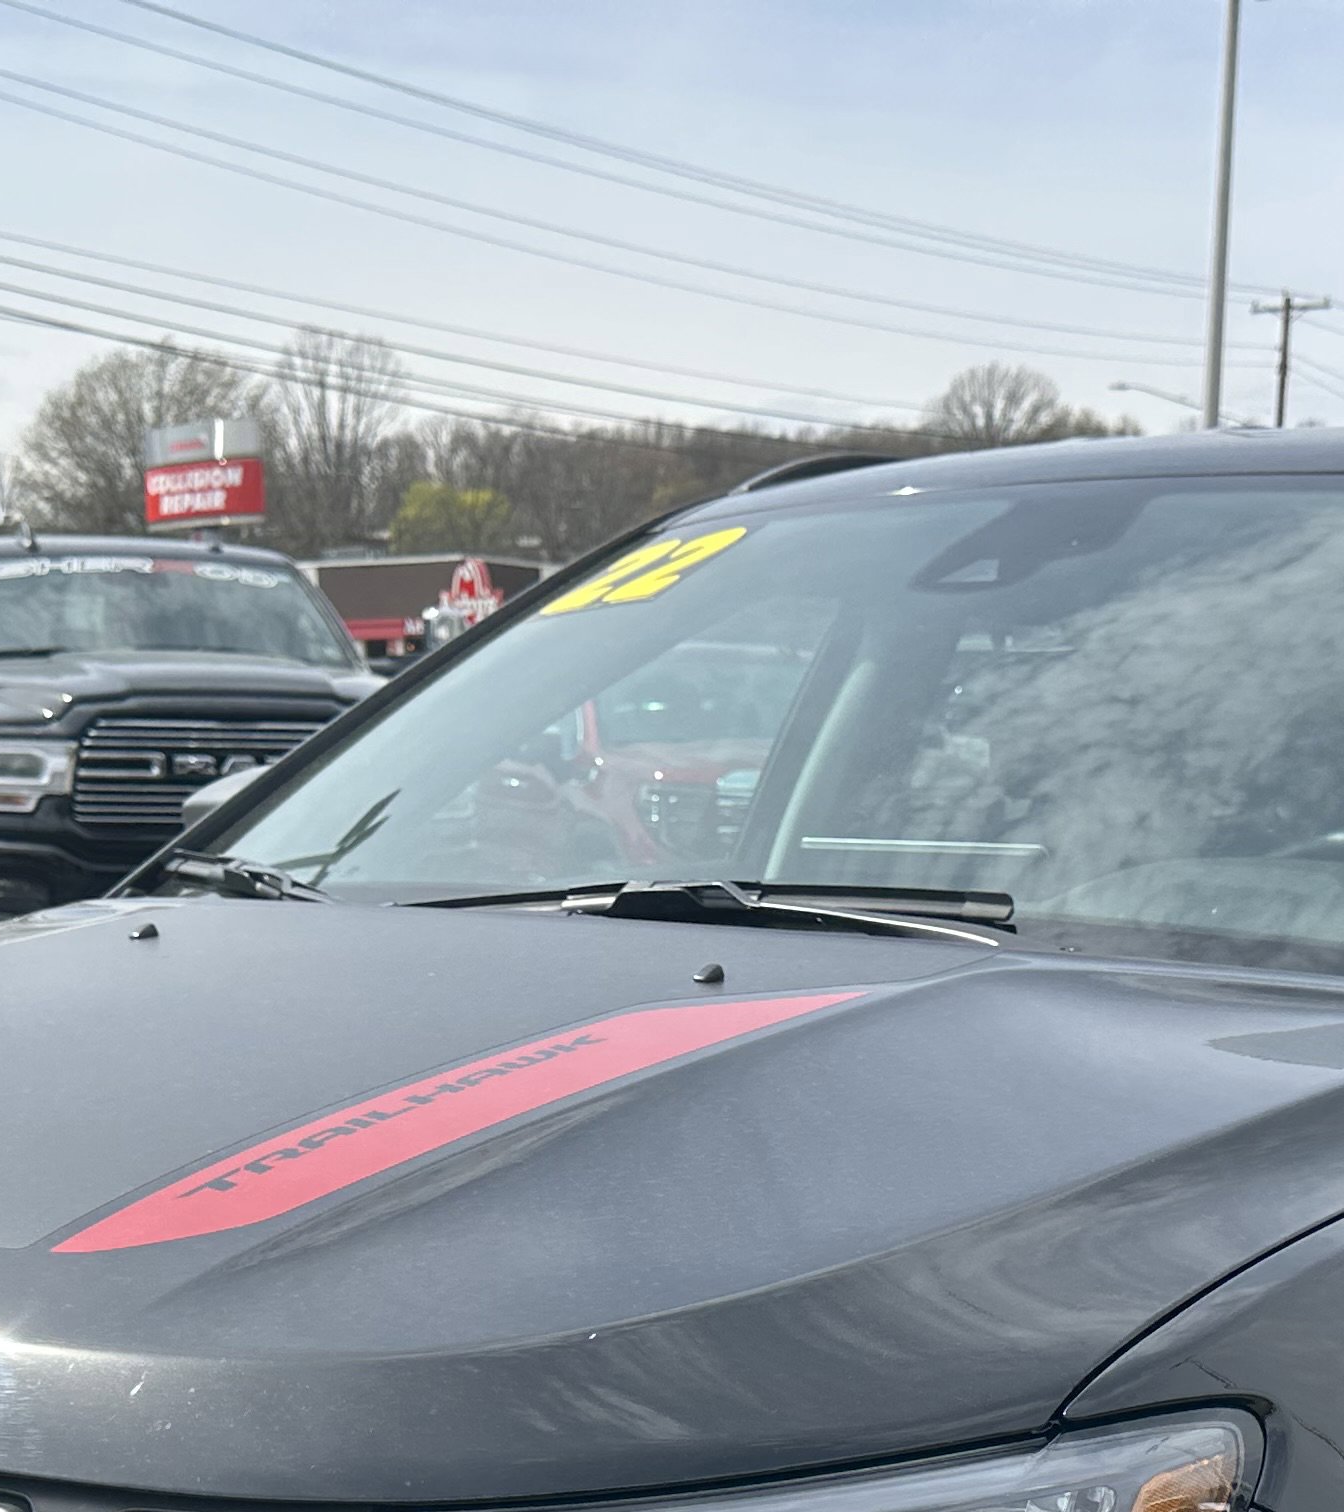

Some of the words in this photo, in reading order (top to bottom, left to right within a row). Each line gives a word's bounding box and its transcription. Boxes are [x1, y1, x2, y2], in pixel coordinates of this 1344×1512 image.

[146, 465, 244, 495] COLLISION
[159, 488, 227, 516] REPAIR
[172, 753, 283, 776] RA
[175, 1033, 608, 1199] TRAILHAWK
